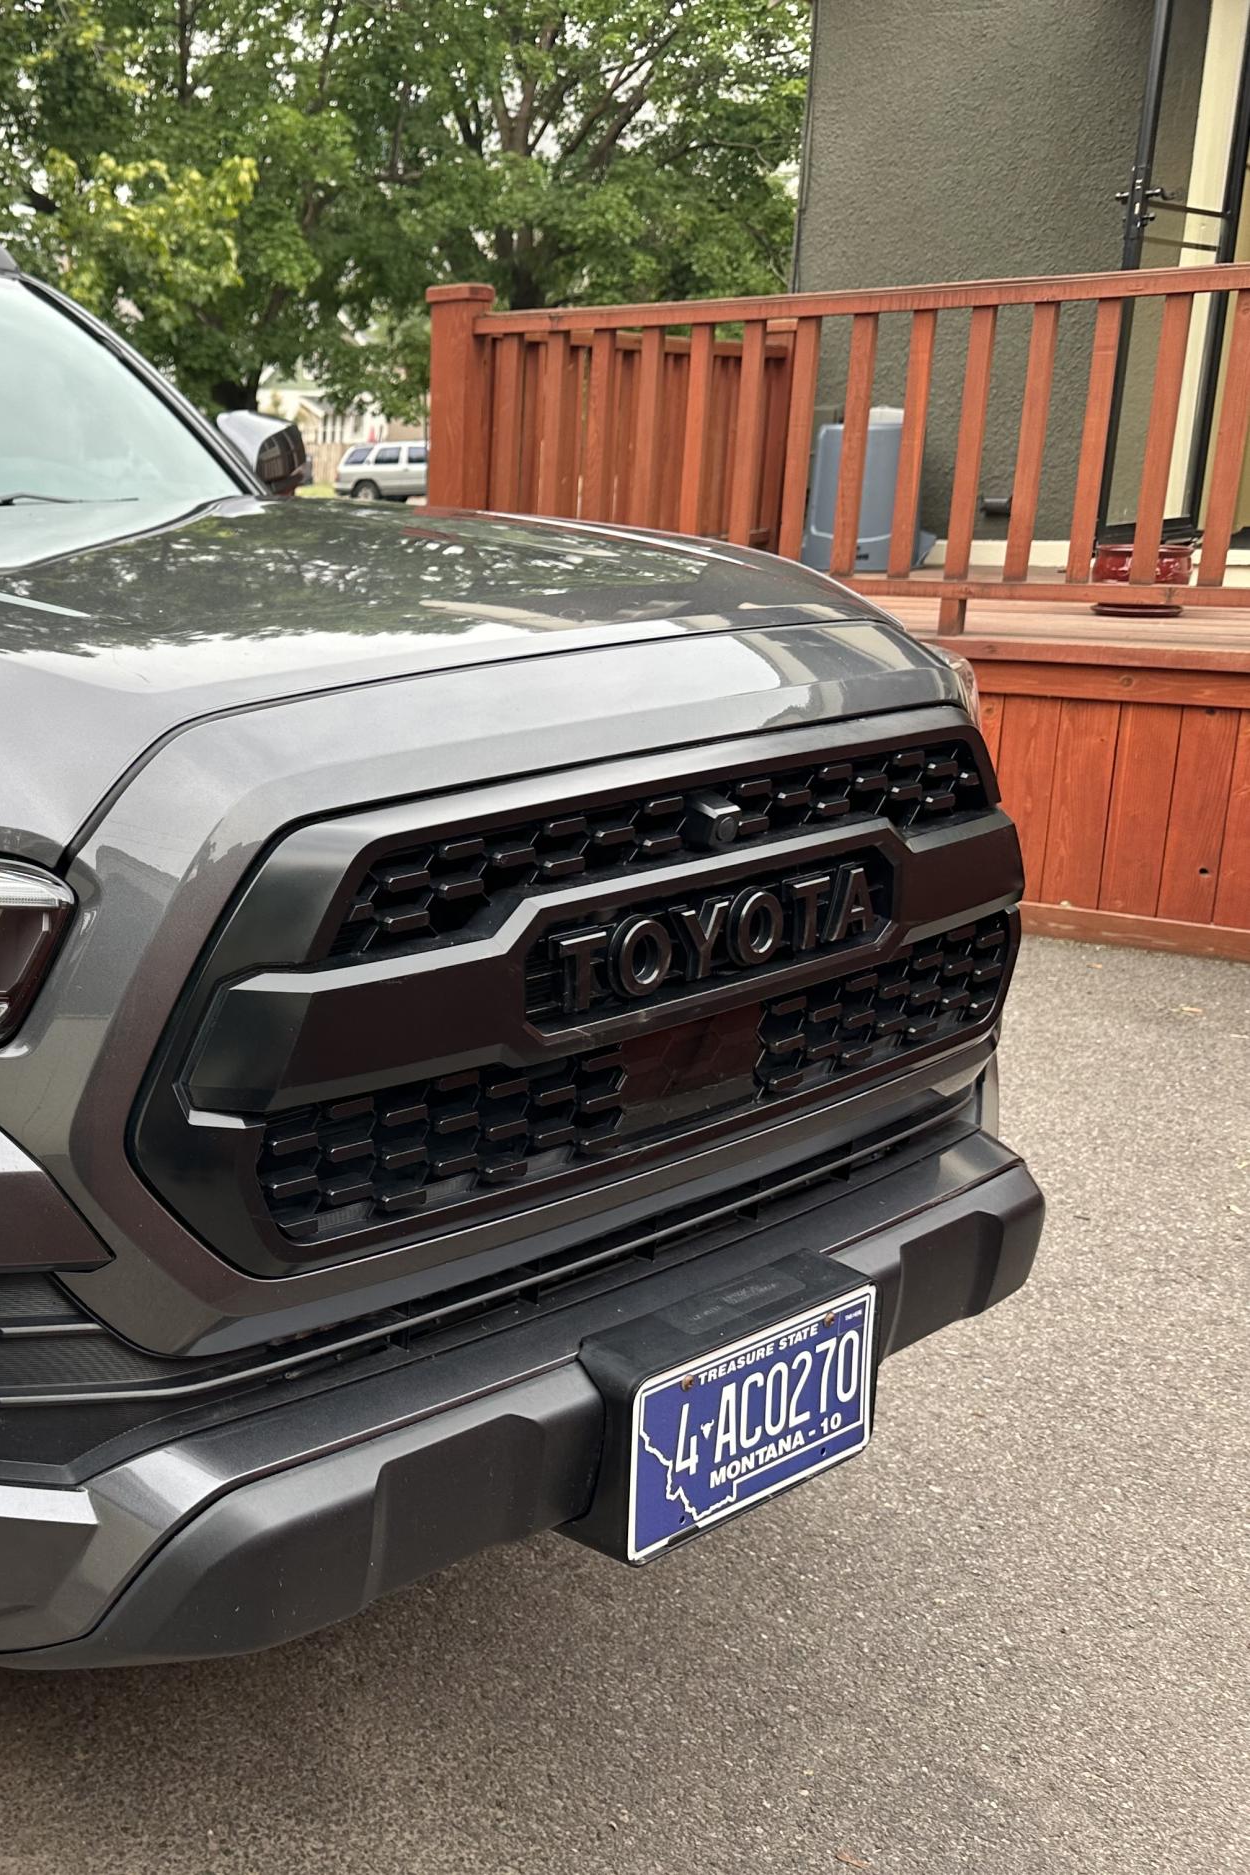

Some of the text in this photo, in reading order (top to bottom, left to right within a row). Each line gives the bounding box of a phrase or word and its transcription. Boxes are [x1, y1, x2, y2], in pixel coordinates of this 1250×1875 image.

[551, 865, 873, 1013] TOYOTA
[698, 1323, 819, 1386] TREASURE STATE
[709, 1431, 806, 1489] MONTANA
